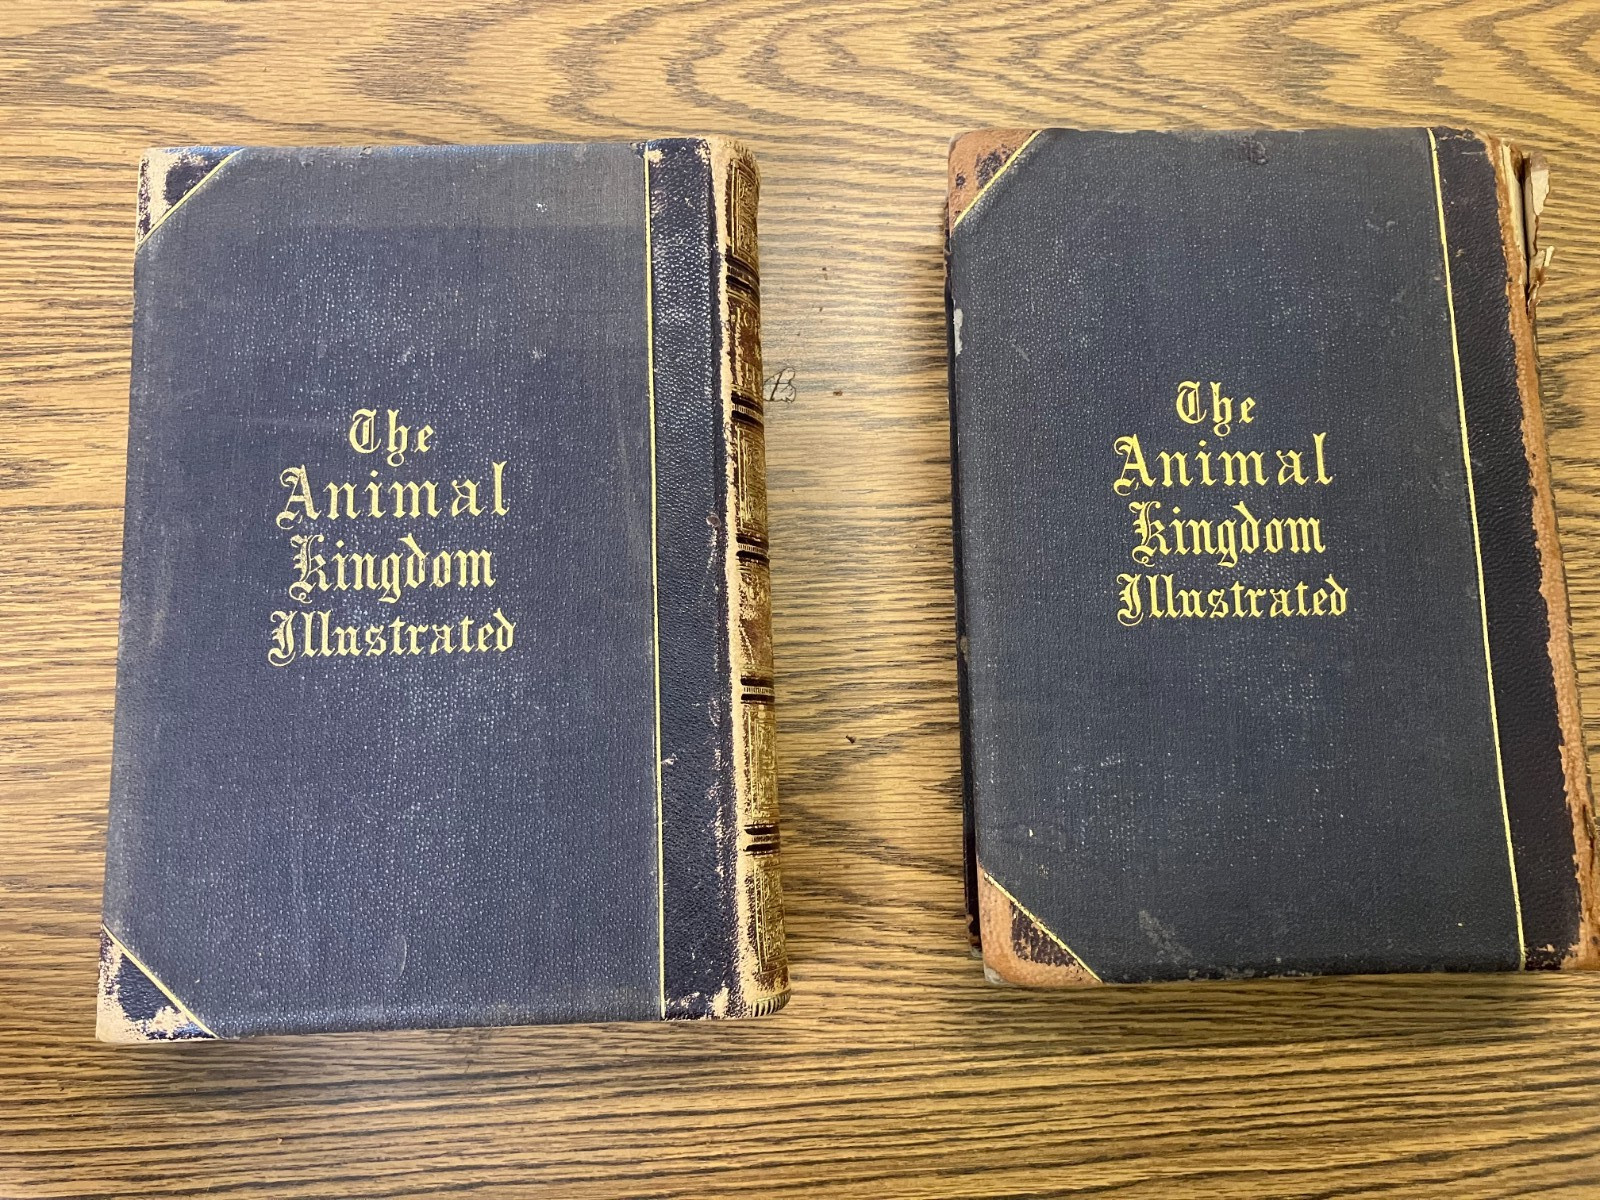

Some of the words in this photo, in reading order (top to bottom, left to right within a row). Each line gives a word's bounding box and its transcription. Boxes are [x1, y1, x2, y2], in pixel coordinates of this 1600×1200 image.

[349, 408, 434, 467] The
[1175, 380, 1256, 437] The
[275, 460, 510, 530] Animal
[1112, 432, 1334, 496] Animal
[1128, 500, 1326, 568] Kingdom
[288, 533, 496, 604] Kingdom
[1116, 573, 1348, 627] Illustrated
[267, 607, 516, 667] Illustrated
